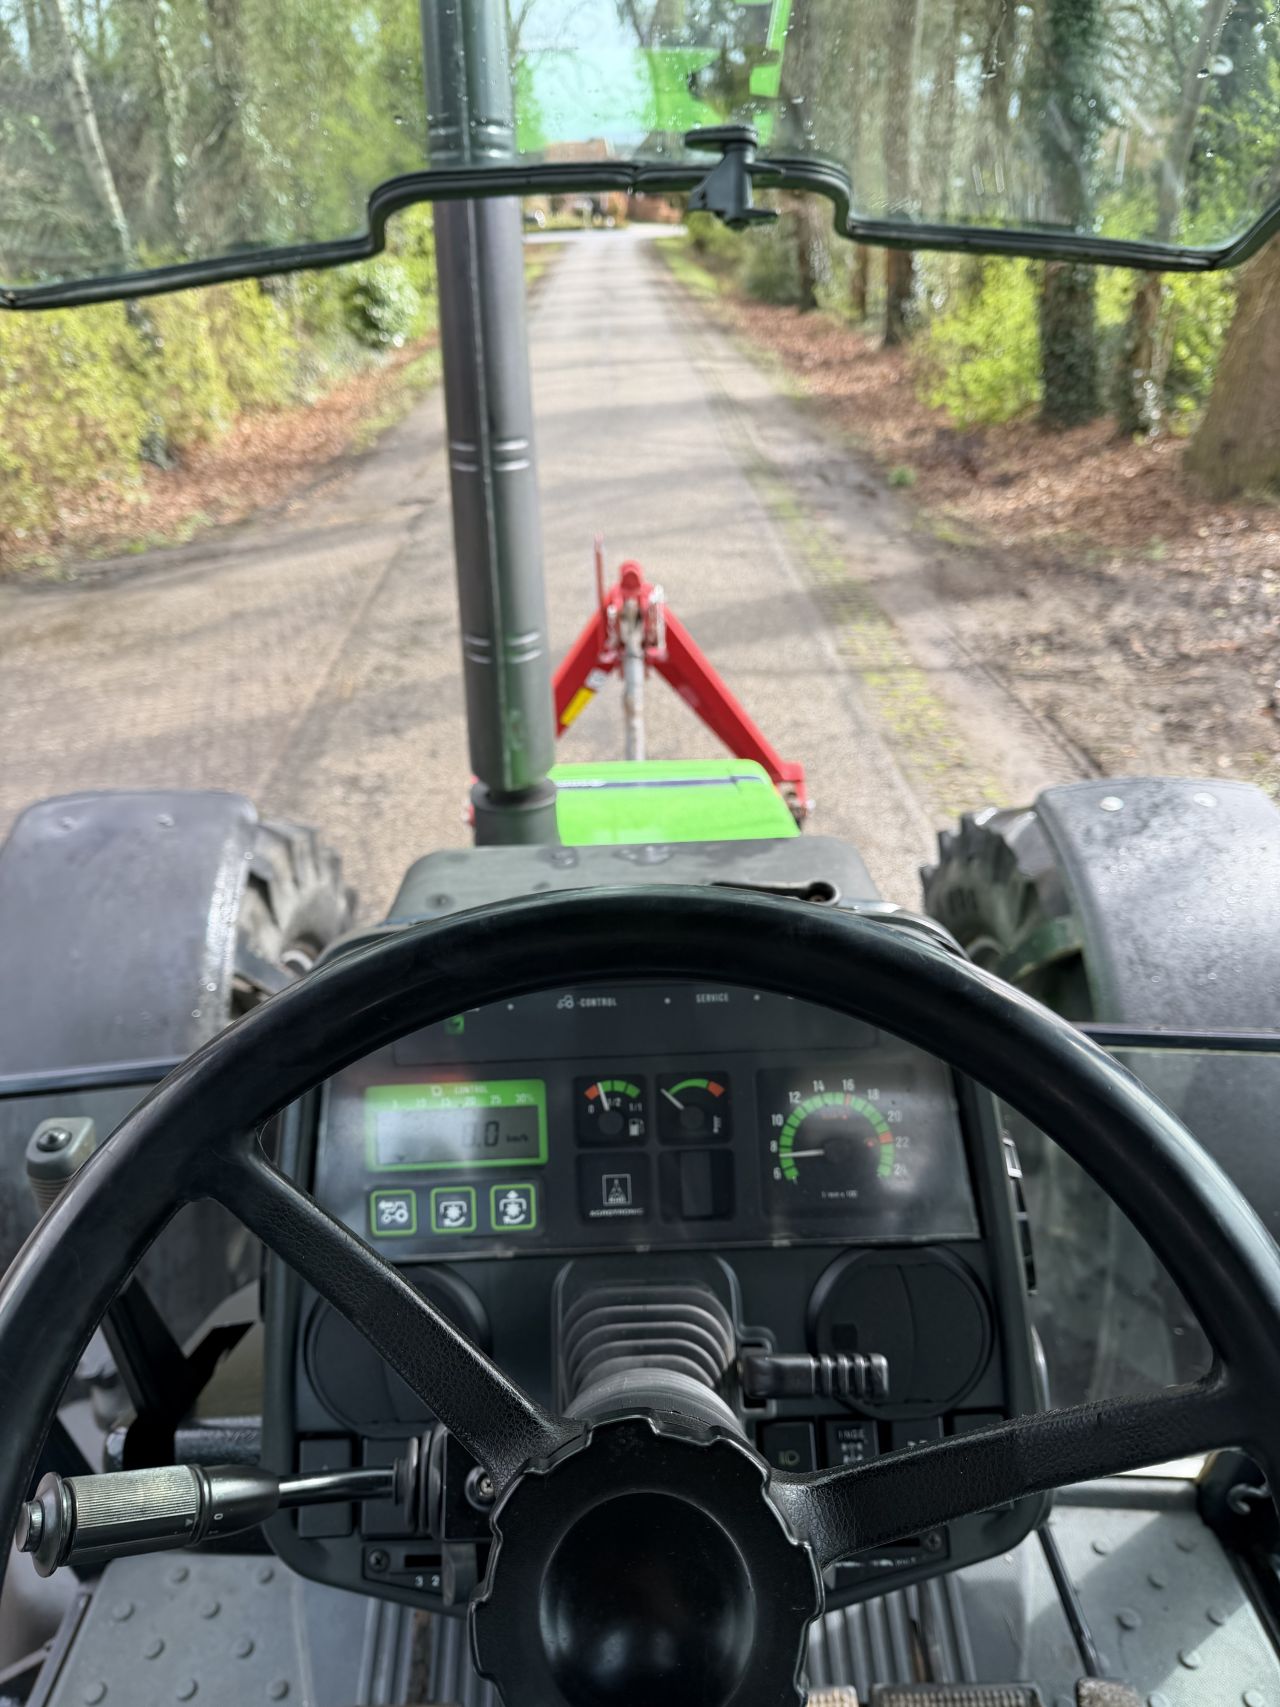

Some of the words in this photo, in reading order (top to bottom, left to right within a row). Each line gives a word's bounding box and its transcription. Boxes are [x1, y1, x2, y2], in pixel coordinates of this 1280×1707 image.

[696, 993, 729, 1003] SERVICE
[813, 1080, 825, 1092] 14
[843, 1079, 855, 1091] 16
[789, 1091, 801, 1104] 12
[867, 1088, 879, 1100] 18
[771, 1114, 784, 1126] 10
[887, 1110, 902, 1122] 20
[770, 1140, 778, 1152] 8
[895, 1136, 910, 1148] 22
[773, 1167, 782, 1180] 6
[893, 1164, 907, 1176] 24
[431, 1574, 441, 1587] 2
